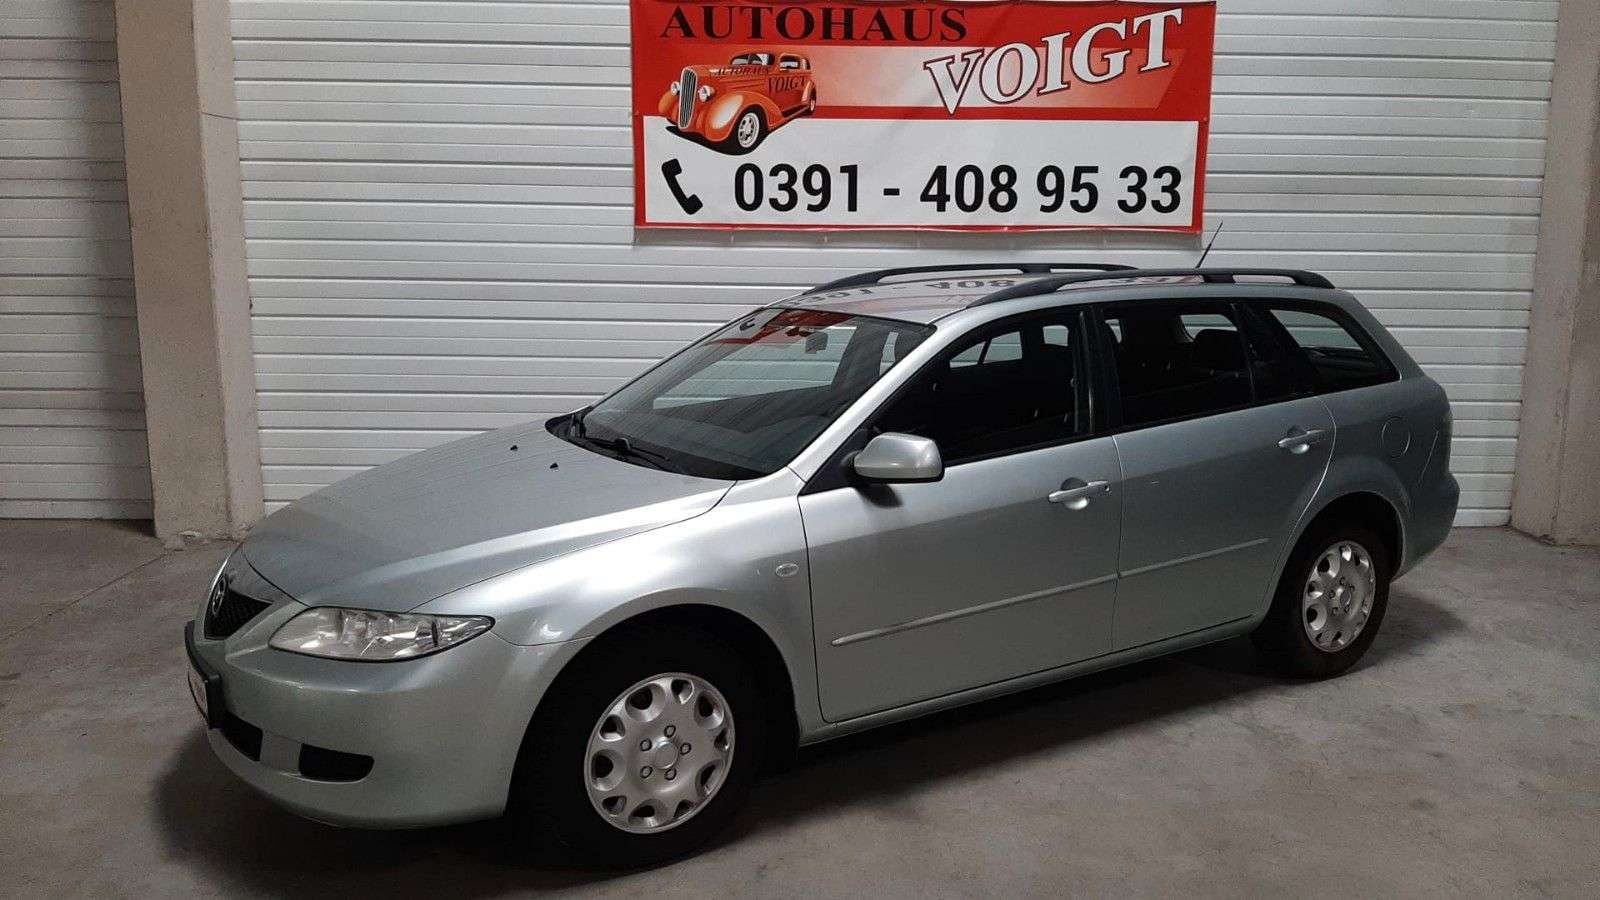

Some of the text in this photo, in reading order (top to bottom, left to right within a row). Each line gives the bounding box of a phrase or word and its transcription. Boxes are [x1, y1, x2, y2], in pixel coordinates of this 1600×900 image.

[660, 6, 966, 42] AUTOHAUS
[925, 8, 1184, 114] VOIGT
[768, 75, 806, 92] VOIGT
[735, 163, 857, 213] 0391
[920, 165, 1017, 213] 408
[1037, 165, 1098, 213] 95
[1118, 165, 1181, 213] 33
